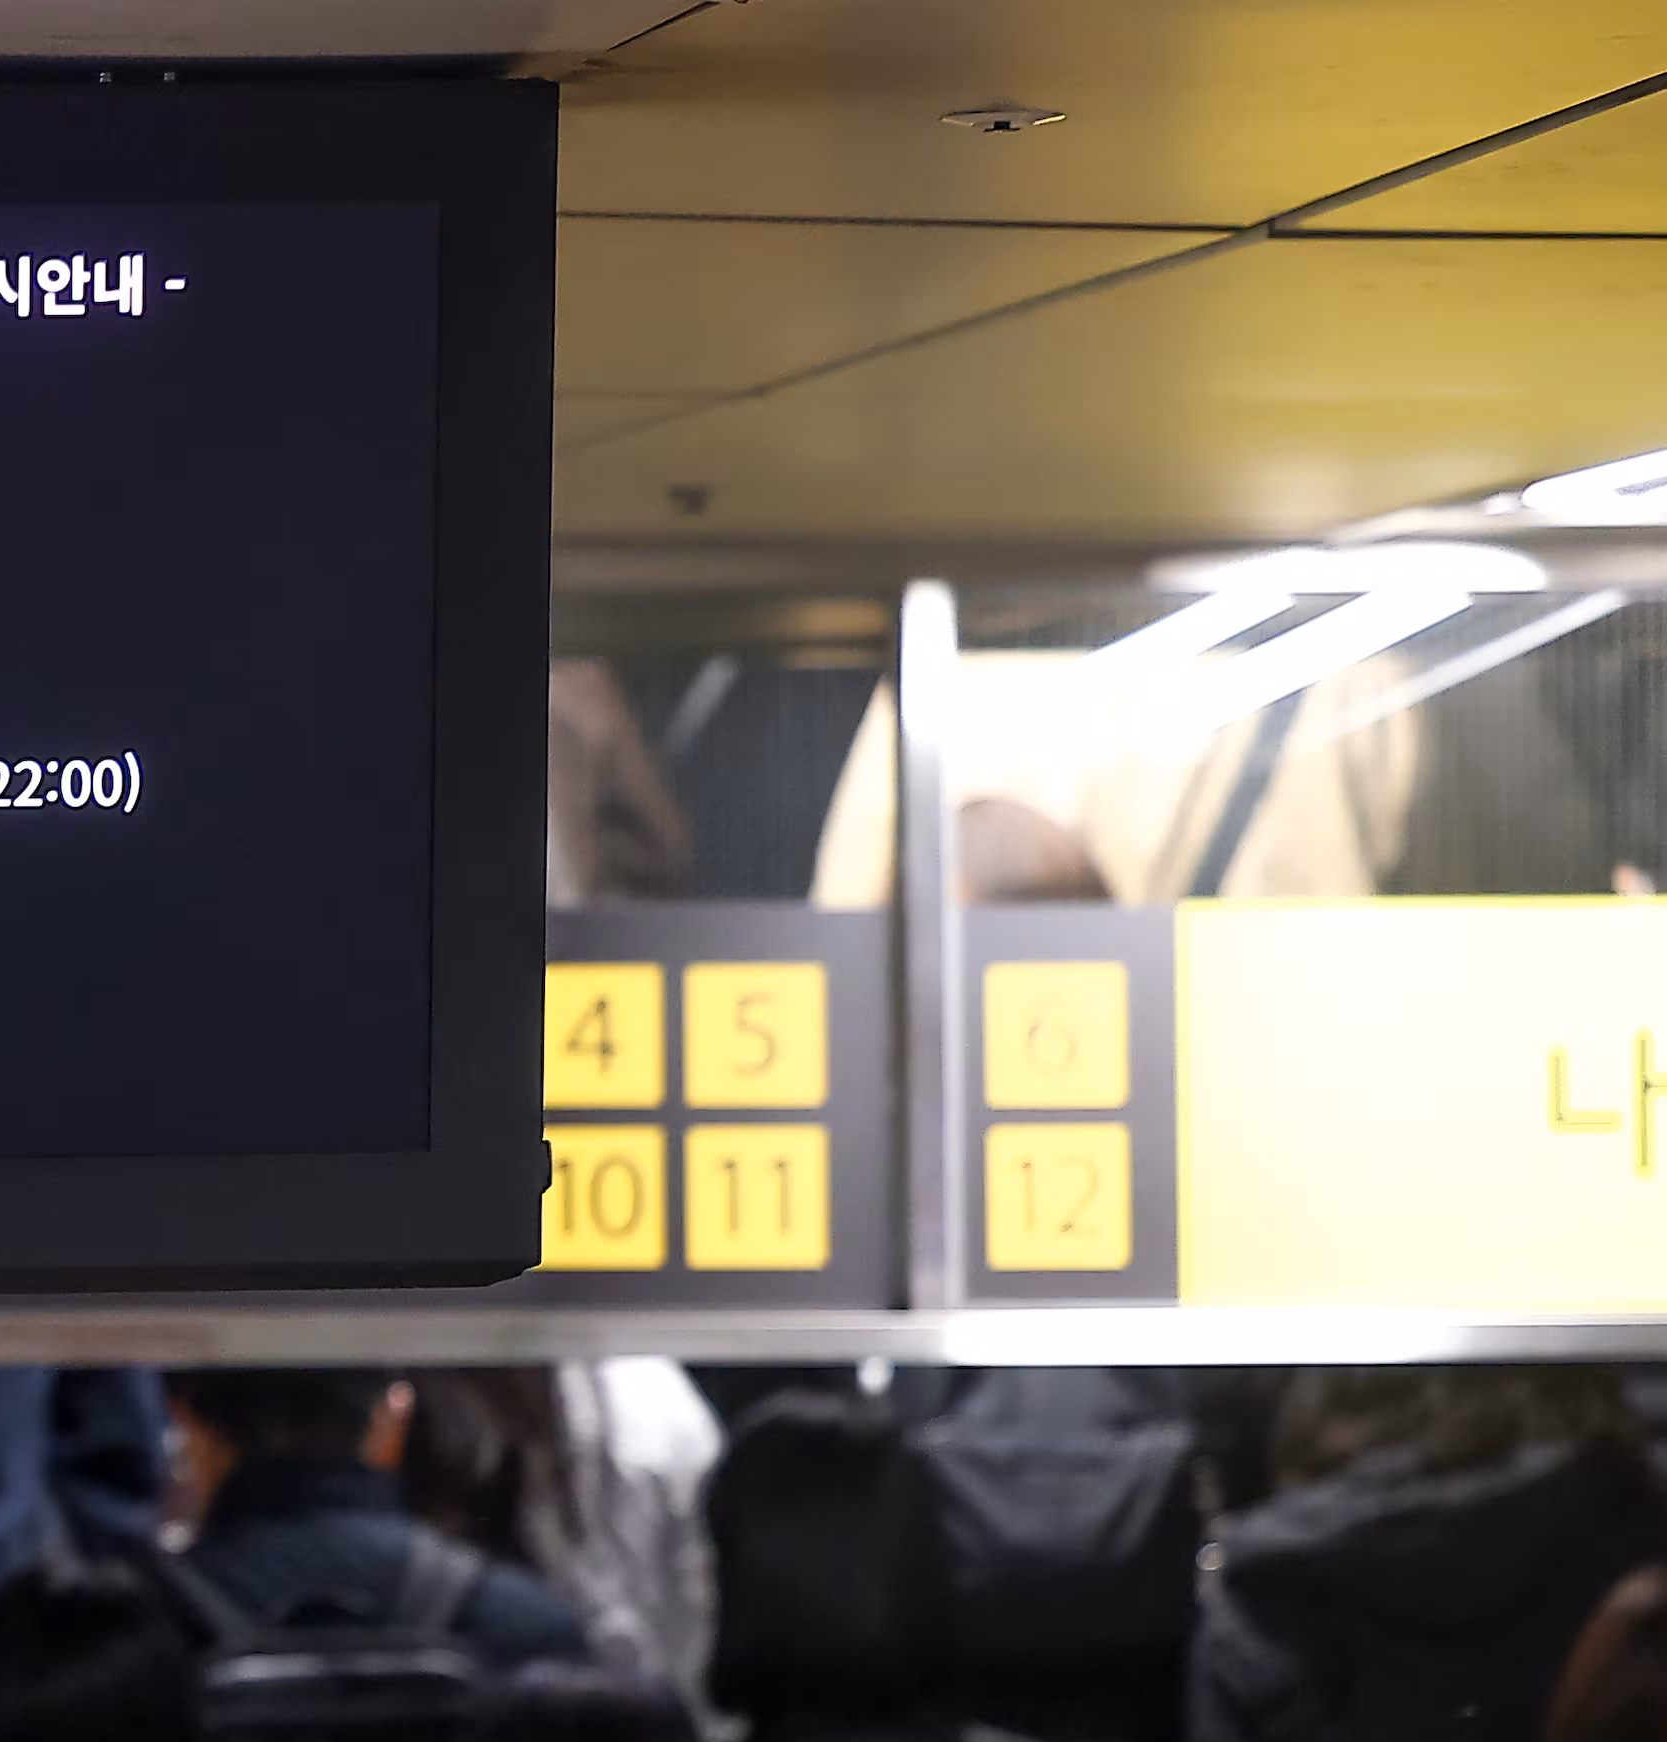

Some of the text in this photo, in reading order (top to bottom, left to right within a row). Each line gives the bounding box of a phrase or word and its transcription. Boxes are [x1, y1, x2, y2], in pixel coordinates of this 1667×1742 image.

[566, 995, 615, 1073] 4
[733, 991, 777, 1078] 5
[1025, 995, 1078, 1075] 6
[554, 1155, 644, 1239] 10
[719, 1156, 790, 1235] 11
[1013, 1157, 1103, 1238] 12
